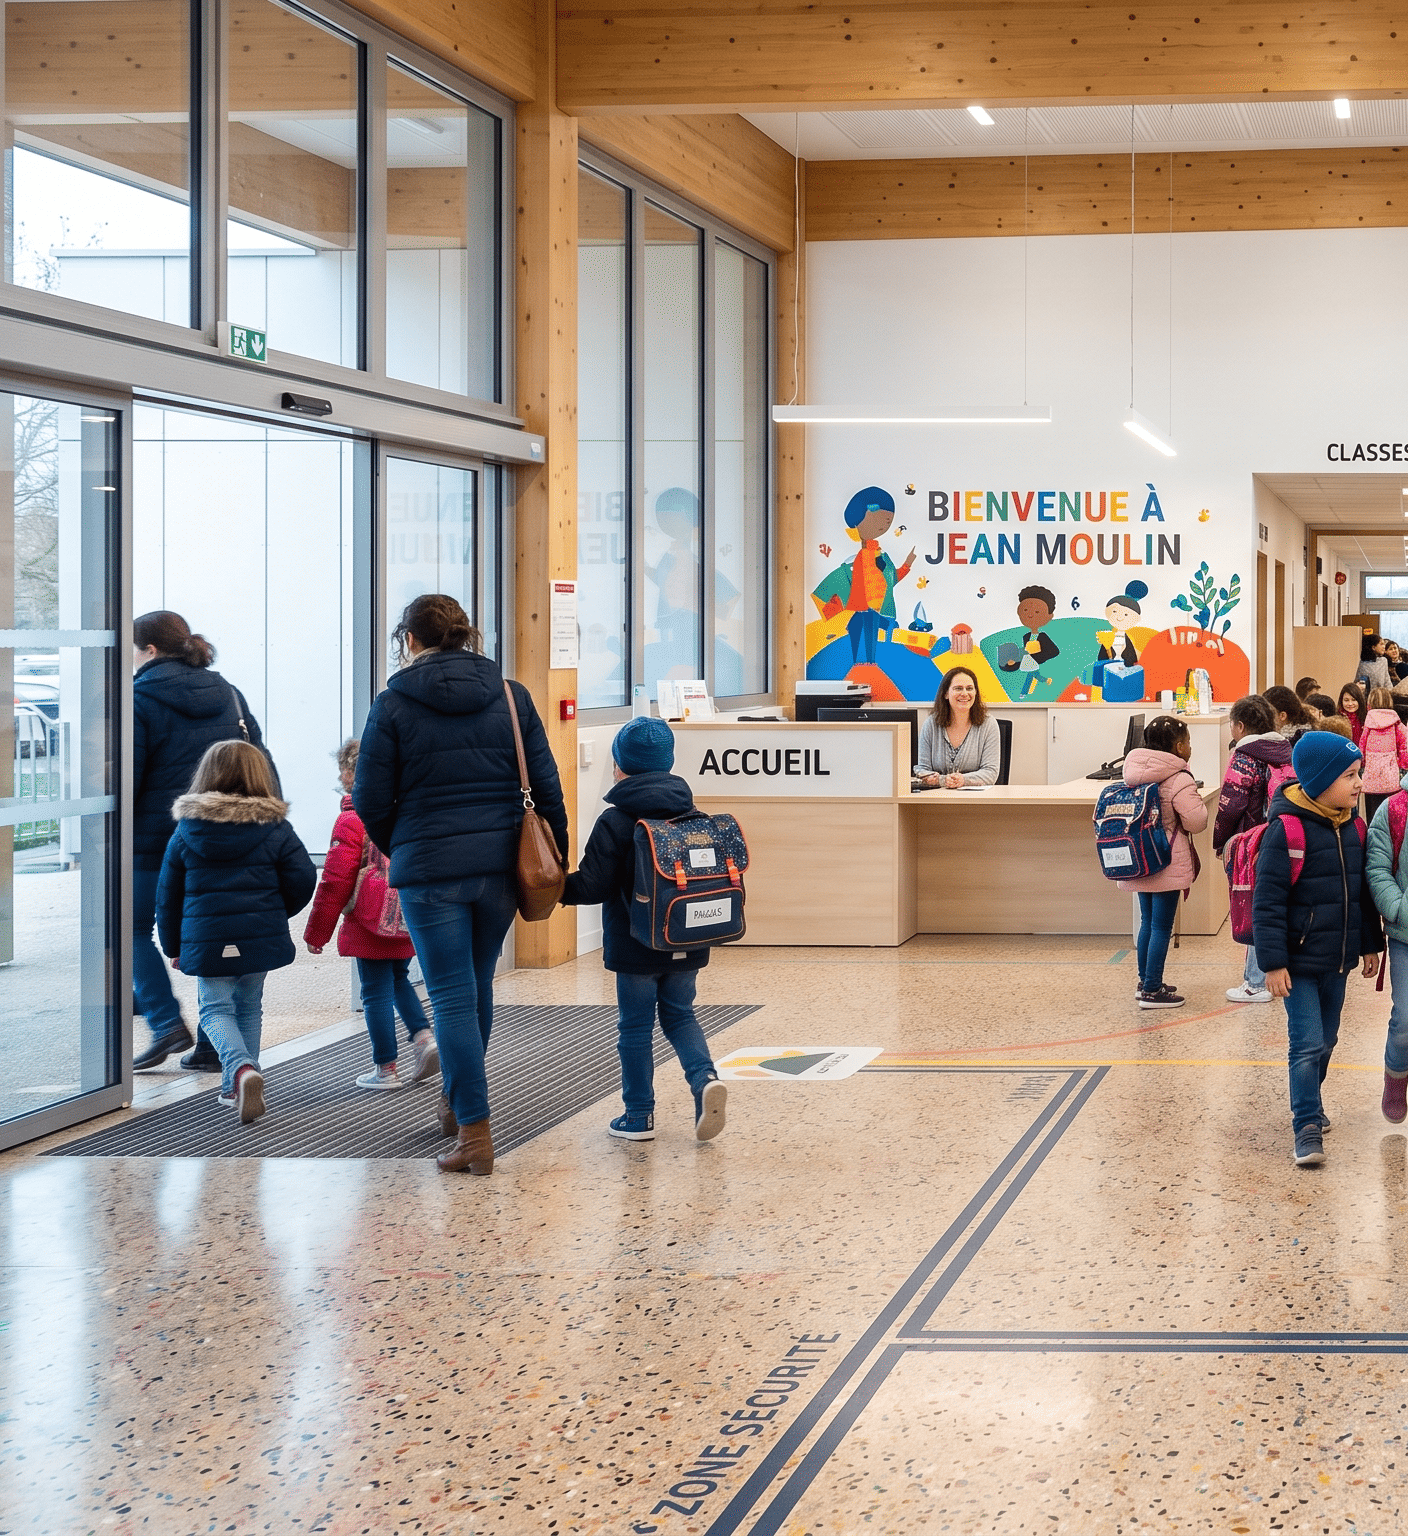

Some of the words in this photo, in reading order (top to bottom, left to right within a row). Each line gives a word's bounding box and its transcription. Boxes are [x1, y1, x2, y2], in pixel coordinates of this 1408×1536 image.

[928, 490, 1129, 523] BIENVENUE
[1140, 482, 1166, 522] À
[924, 532, 1022, 566] JEAN
[1036, 532, 1181, 566] MOULIN
[698, 748, 831, 776] ACCUEIL
[650, 1444, 751, 1516] ZONE
